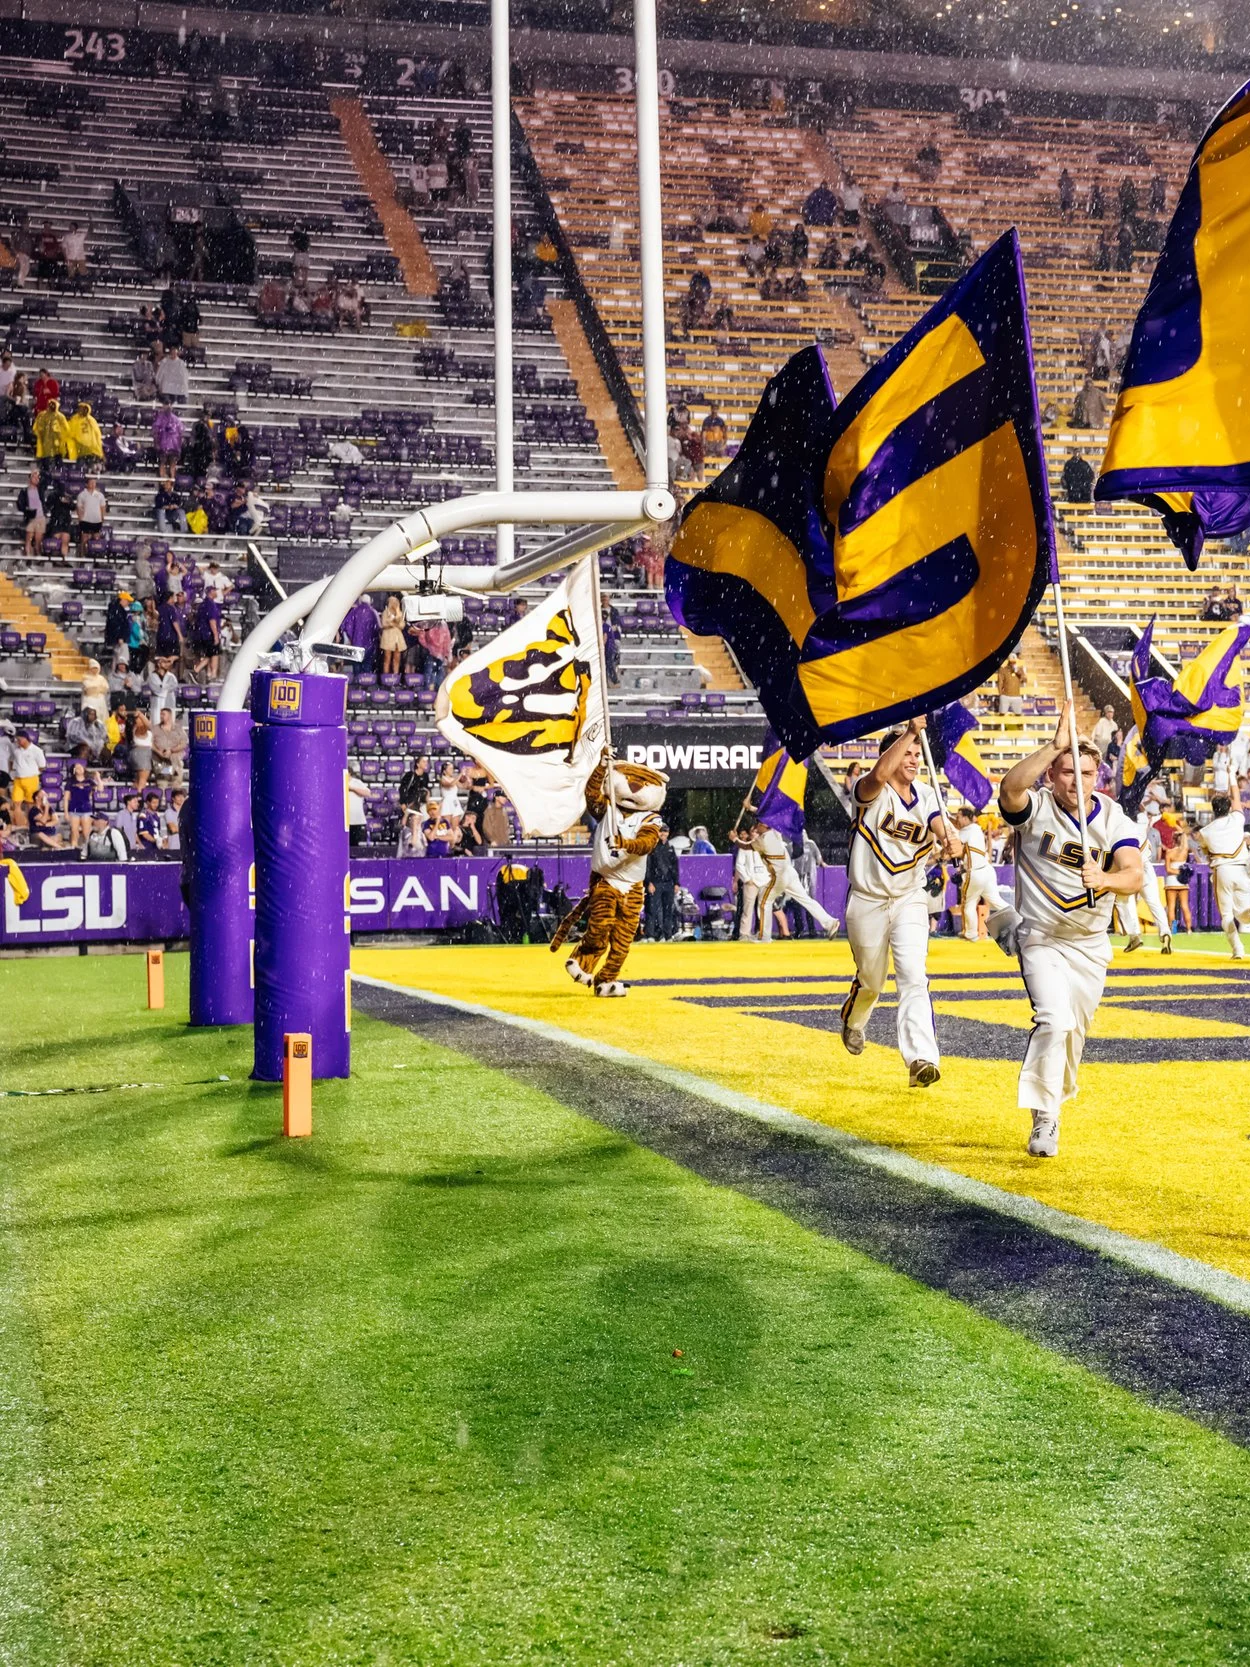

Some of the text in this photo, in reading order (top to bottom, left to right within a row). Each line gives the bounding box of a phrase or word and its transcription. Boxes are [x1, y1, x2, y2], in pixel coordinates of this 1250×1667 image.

[64, 30, 126, 61] 243
[613, 67, 675, 95] 30
[273, 686, 296, 702] 100
[877, 811, 928, 846] LSU
[5, 875, 128, 934] LSU
